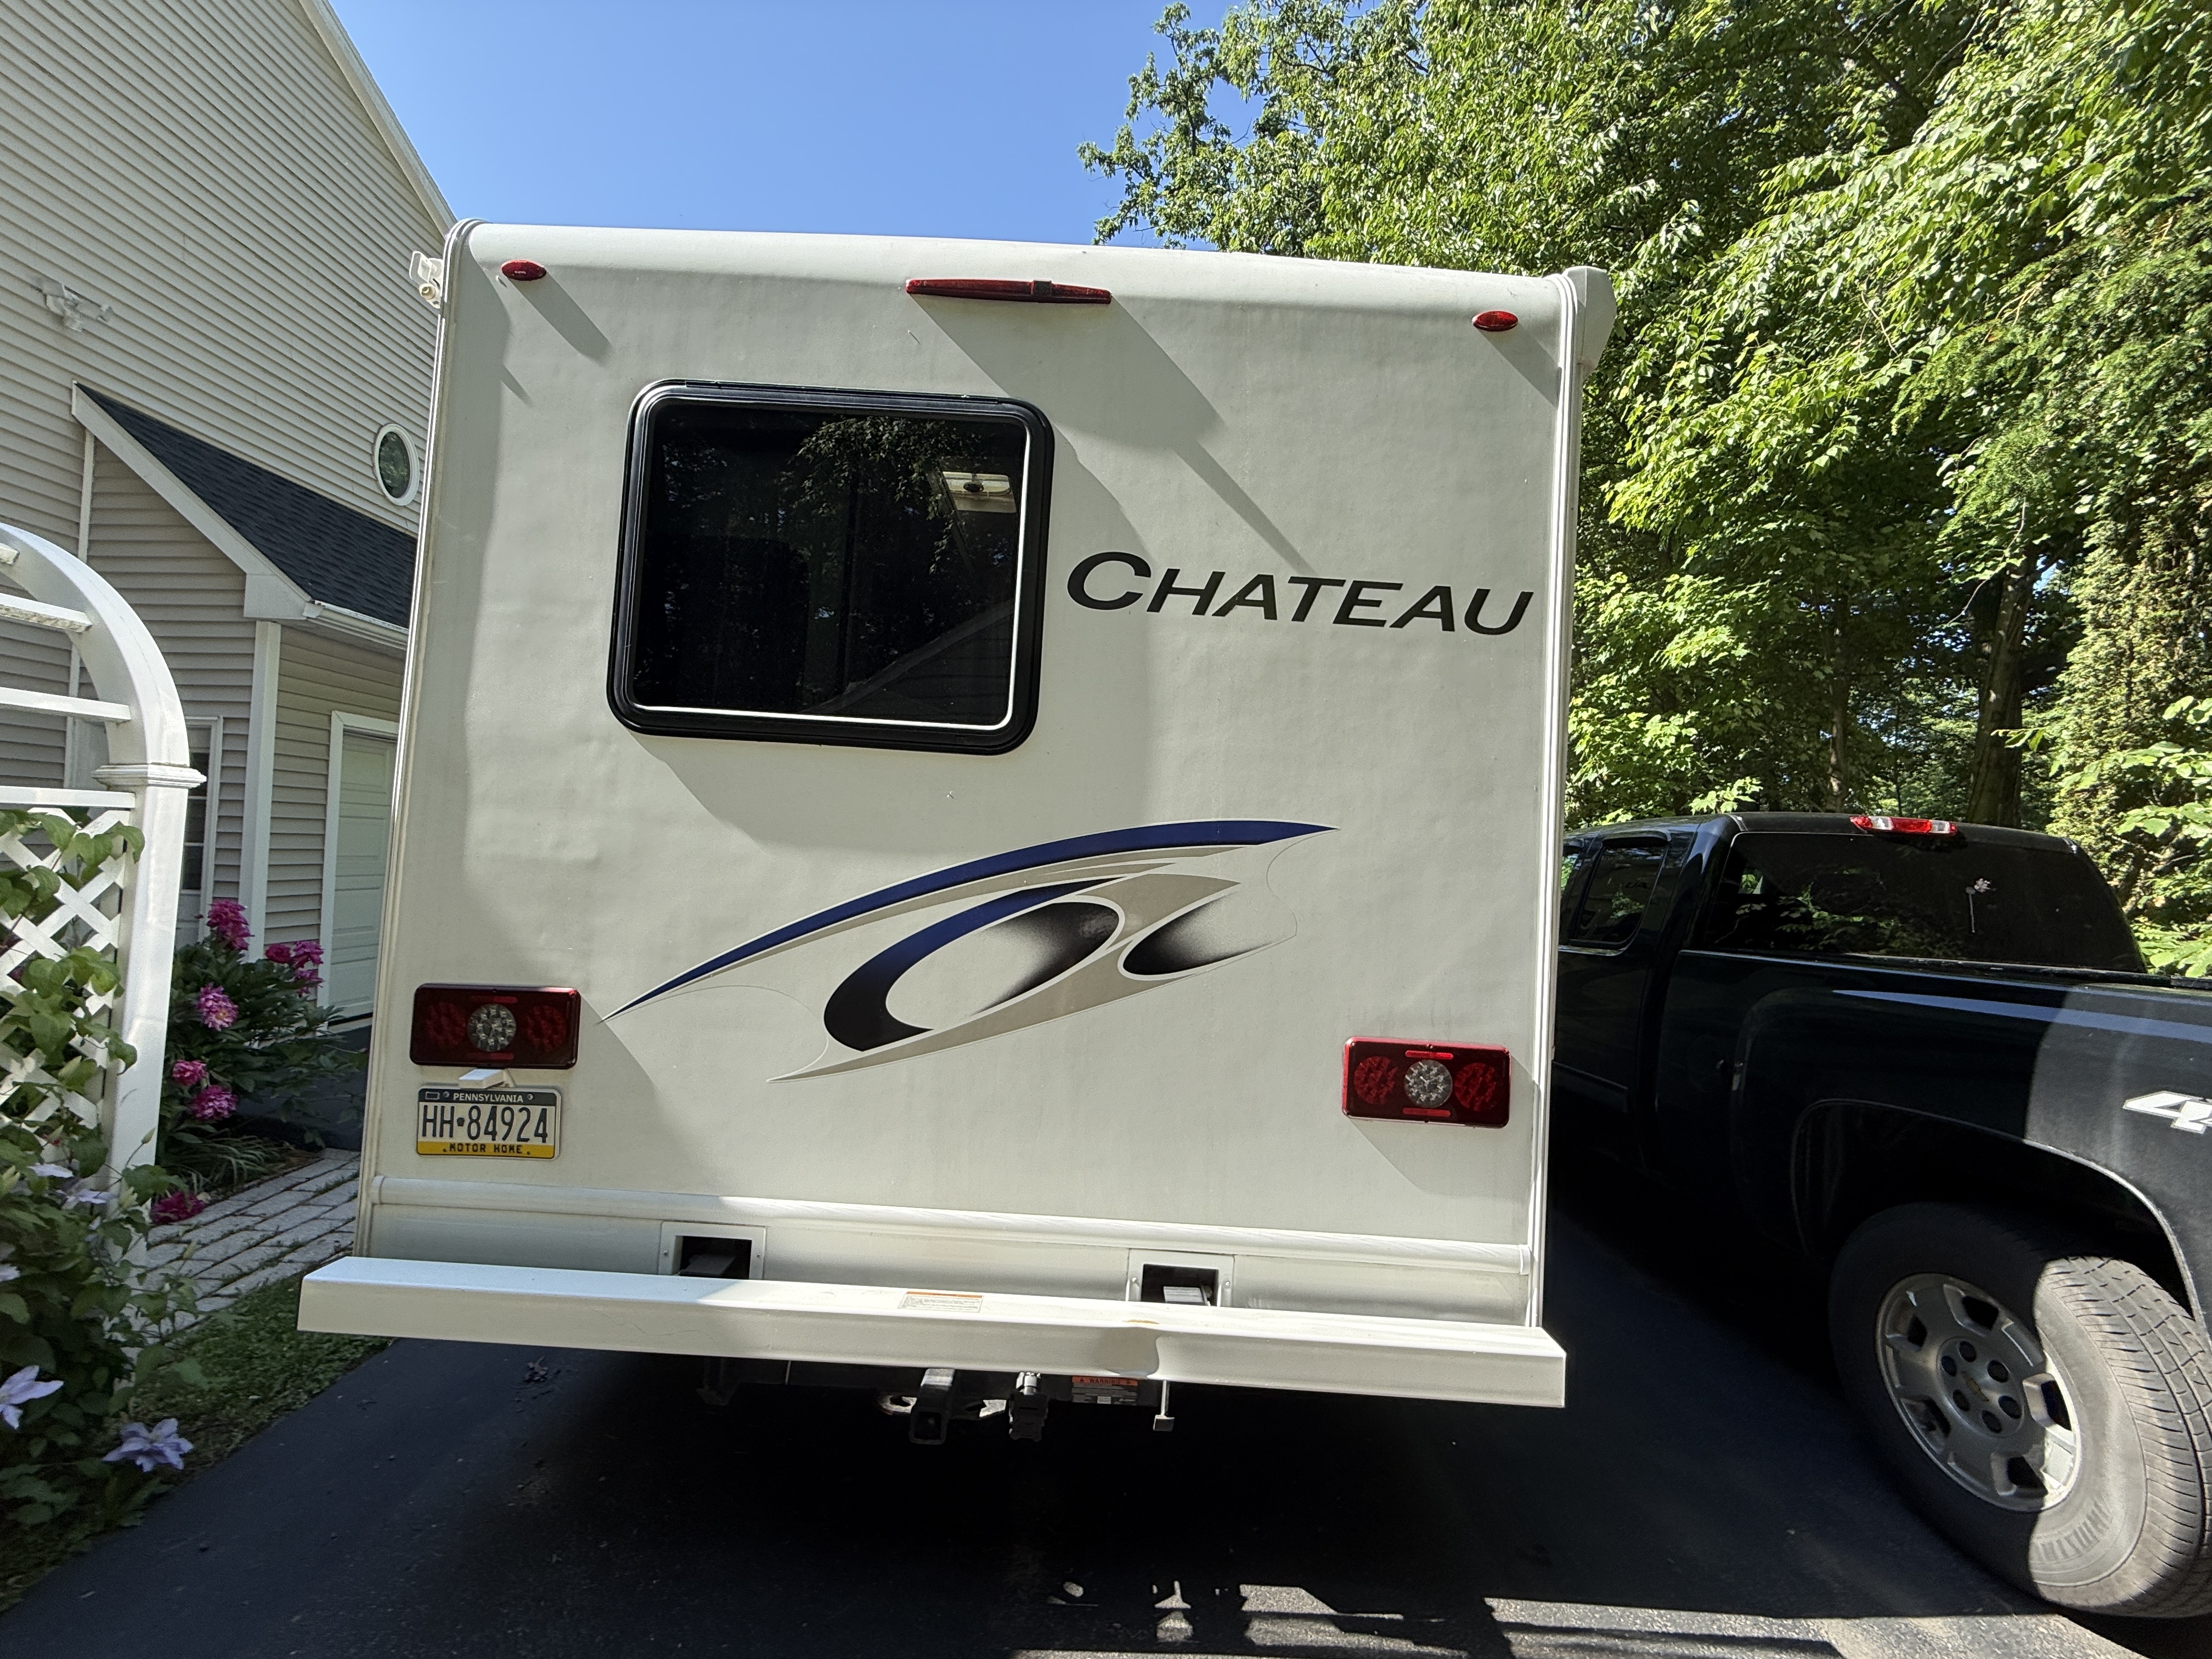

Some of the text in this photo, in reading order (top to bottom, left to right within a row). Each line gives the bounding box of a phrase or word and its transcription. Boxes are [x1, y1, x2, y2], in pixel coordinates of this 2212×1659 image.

[1067, 551, 1534, 636] CHATEAU
[453, 1092, 524, 1103] PENNSYLVANIA
[2122, 1091, 2212, 1135] 4
[449, 1142, 522, 1154] MOTOR HOME
[1090, 1376, 1121, 1385] WARNING
